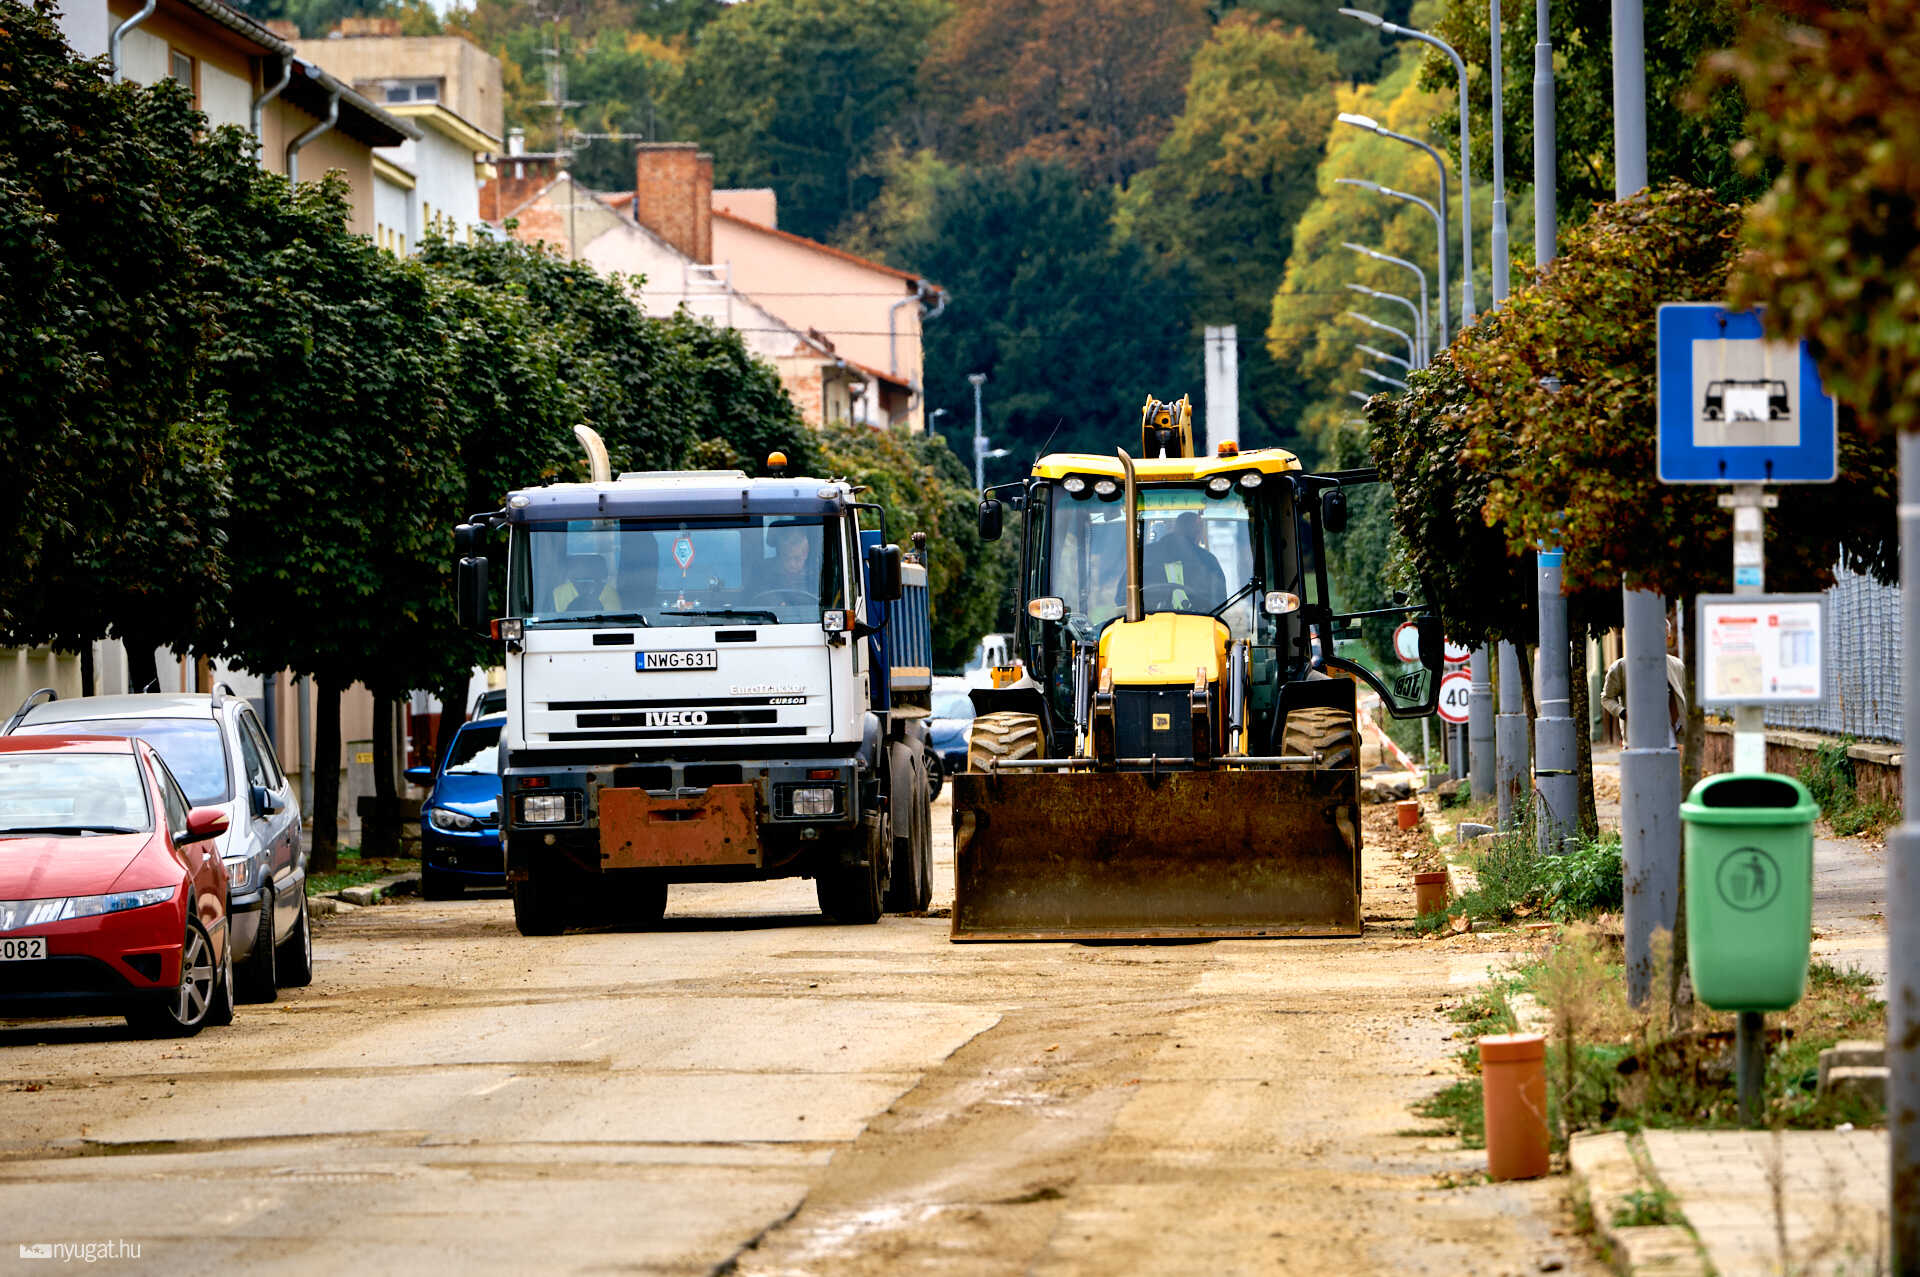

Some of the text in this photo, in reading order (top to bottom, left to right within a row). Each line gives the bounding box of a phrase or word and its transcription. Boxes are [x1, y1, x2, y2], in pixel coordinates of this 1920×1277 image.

[647, 653, 712, 667] NWG-631
[769, 697, 805, 705] CURSOR
[1446, 688, 1469, 707] 40
[645, 711, 708, 726] IVECO
[0, 940, 41, 959] 082
